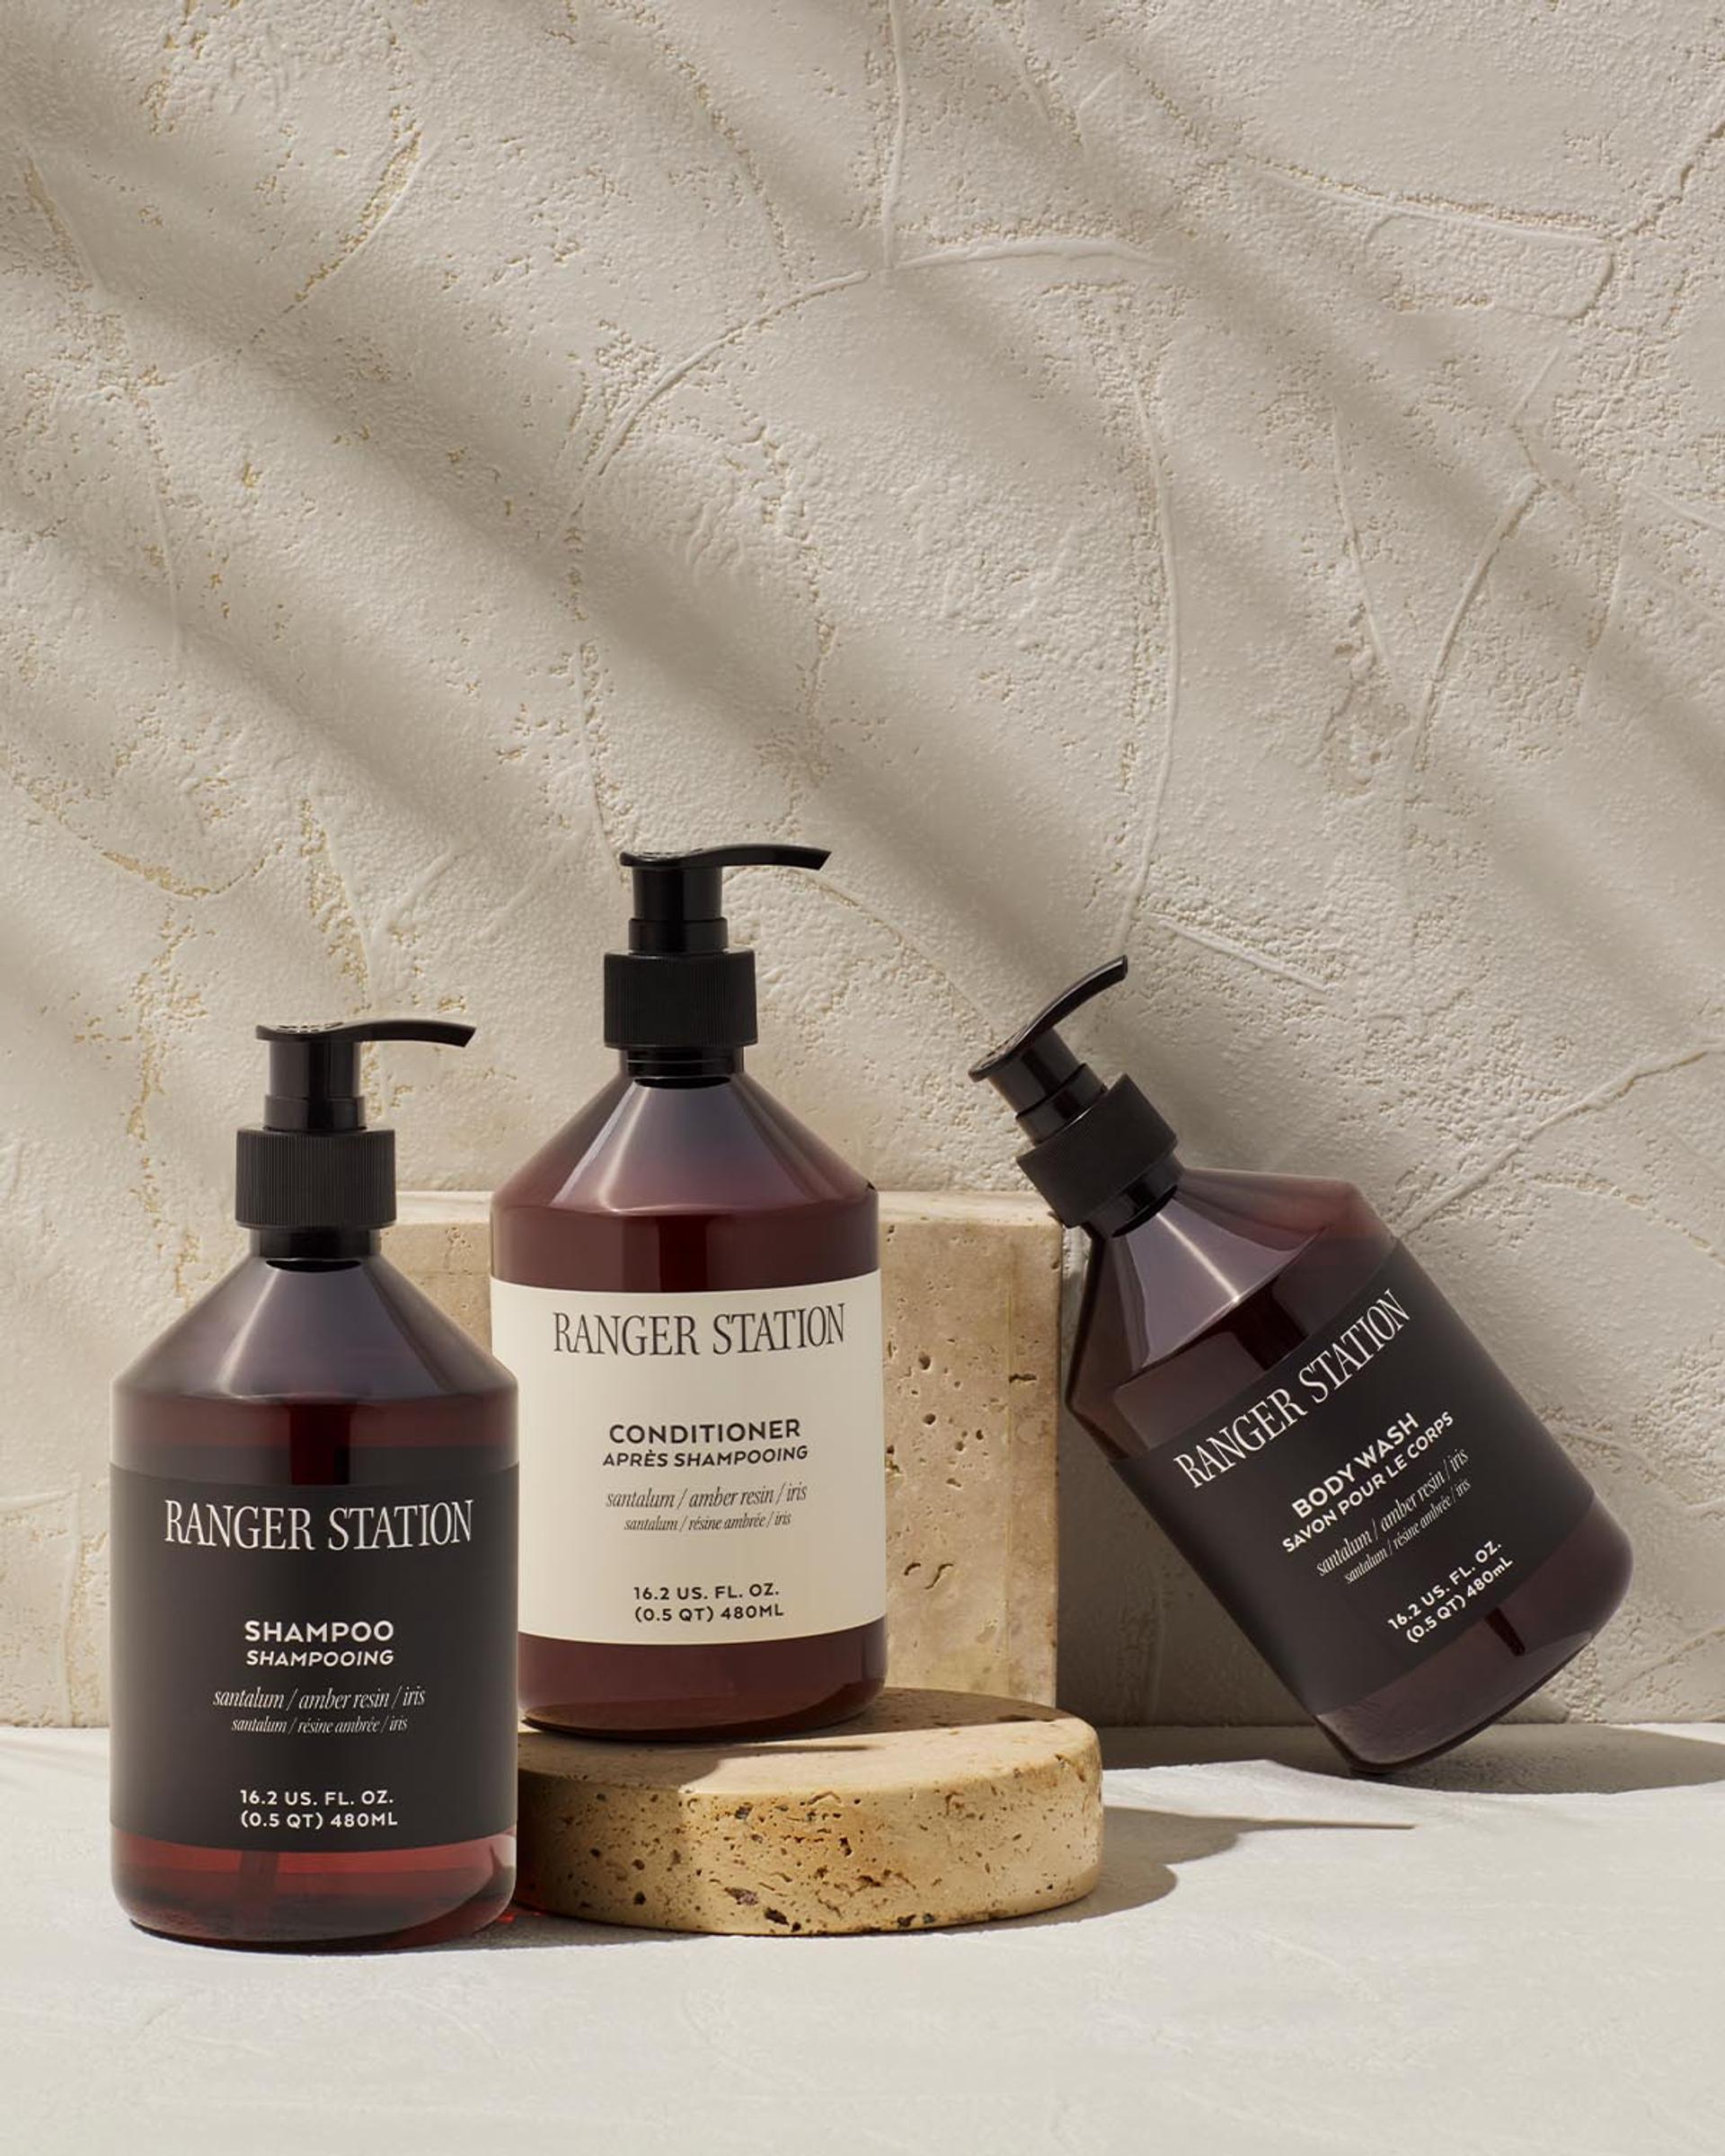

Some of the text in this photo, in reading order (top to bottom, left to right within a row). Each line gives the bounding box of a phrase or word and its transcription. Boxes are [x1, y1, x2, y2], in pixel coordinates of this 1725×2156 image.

[553, 1303, 845, 1356] RANGER STATION
[1173, 1288, 1411, 1489] RANGER STATION
[609, 1418, 801, 1445] CONDITIONER
[602, 1445, 809, 1468] APRÈS SHAMPOOING
[1291, 1411, 1420, 1519] BODY WASH
[606, 1487, 675, 1508] santalum
[688, 1486, 739, 1507] amber
[739, 1485, 774, 1505] resin
[786, 1481, 808, 1502] iris
[1281, 1410, 1454, 1553] SAVON POUR LE CORPS
[164, 1499, 473, 1551] RANGER STATION
[624, 1515, 678, 1531] santalum
[774, 1510, 792, 1525] iris
[1316, 1529, 1374, 1577] santalum
[1380, 1492, 1418, 1533] amber
[1416, 1471, 1445, 1502] resin
[1448, 1447, 1469, 1472] iris
[1345, 1547, 1389, 1584] santalum
[1454, 1478, 1471, 1498] iris
[633, 1582, 780, 1600] 16.2 US. FL. OZ.
[1387, 1541, 1502, 1630] 16.2 US. FL. OZ.
[634, 1604, 784, 1623] (0.5 QT) 480ML
[1406, 1615, 1438, 1643] (0.5
[1437, 1594, 1466, 1620] QT)
[244, 1620, 394, 1642] SHAMPOO
[246, 1649, 394, 1667] SHAMPOOING
[212, 1686, 285, 1710] santalum
[298, 1687, 351, 1710] amber
[352, 1688, 390, 1708] resin
[402, 1685, 426, 1707] iris
[231, 1716, 288, 1734] santalum
[389, 1715, 409, 1732] iris
[240, 1789, 394, 1806] 16.2 US. FL. OZ.
[241, 1810, 398, 1830] (0.5 QT) 480ML
